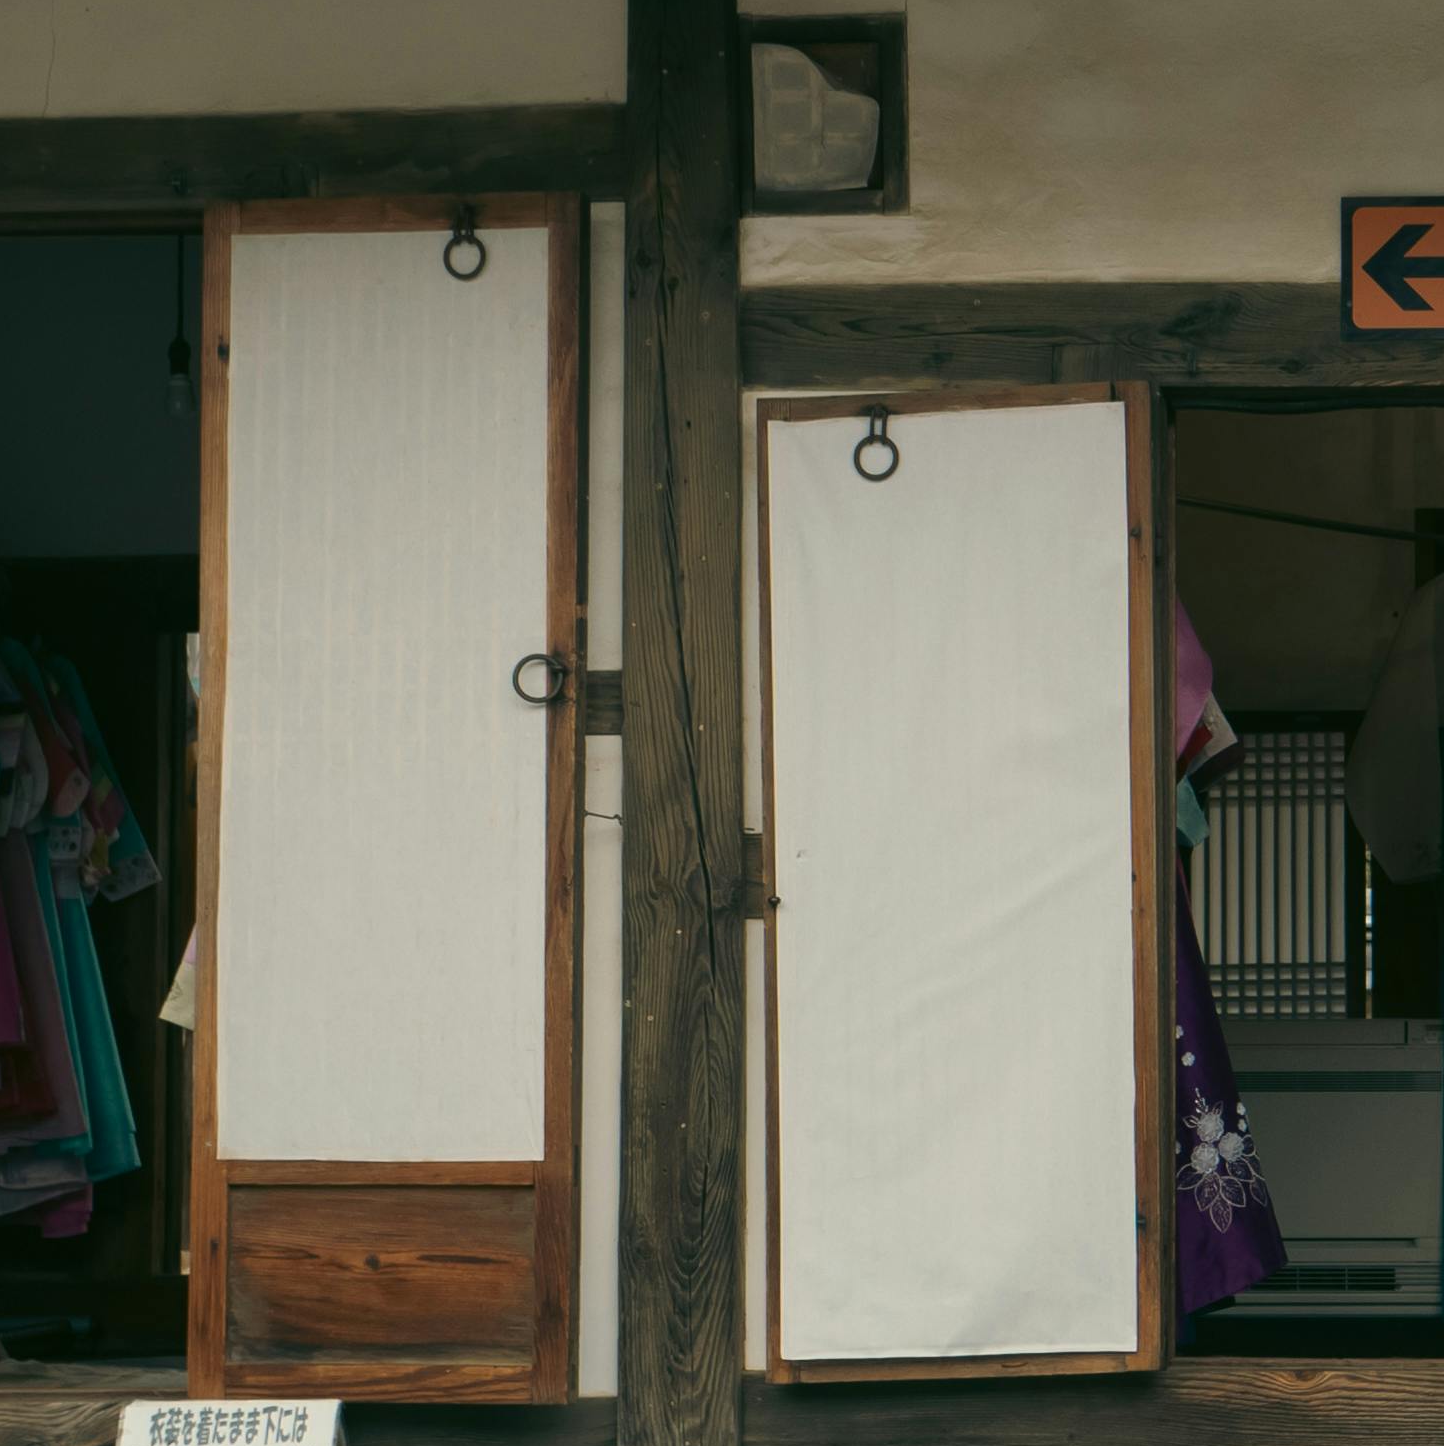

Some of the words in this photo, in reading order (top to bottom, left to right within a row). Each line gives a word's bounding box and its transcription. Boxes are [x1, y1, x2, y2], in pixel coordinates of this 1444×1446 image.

[149, 1406, 309, 1446] 衣装を着たまま下には
